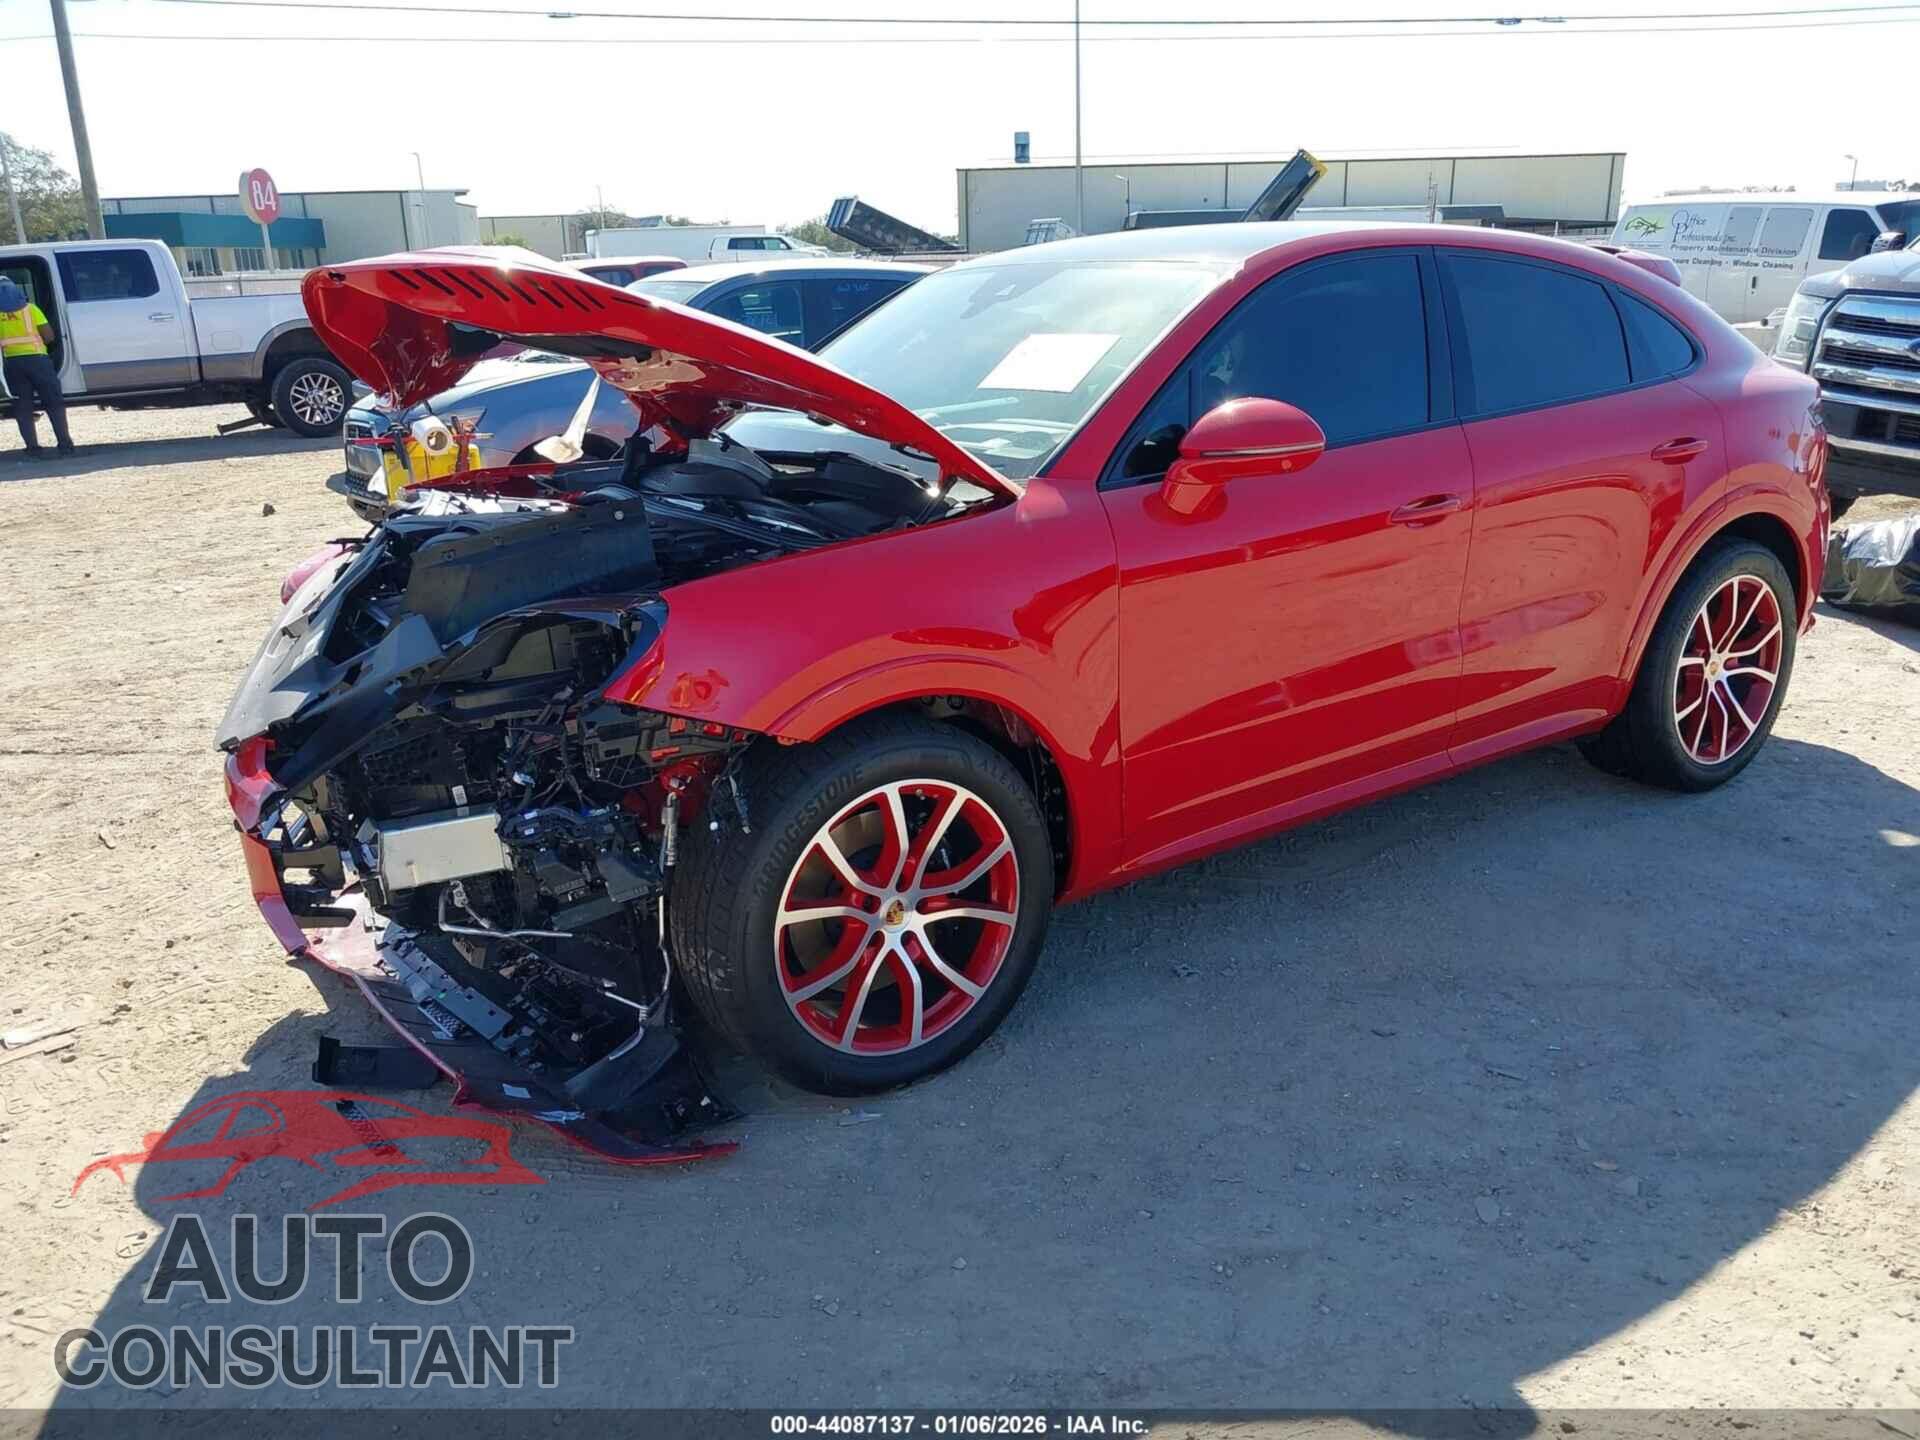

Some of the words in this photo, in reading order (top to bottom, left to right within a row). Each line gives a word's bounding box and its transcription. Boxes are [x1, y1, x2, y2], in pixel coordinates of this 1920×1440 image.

[252, 180, 277, 211] 84
[1670, 244, 1704, 253] Property
[1706, 244, 1759, 254] Maintenance
[1760, 246, 1798, 257] Division
[1692, 257, 1722, 267] Cleaning
[1732, 259, 1760, 267] Window
[1762, 261, 1794, 271] Cleaning
